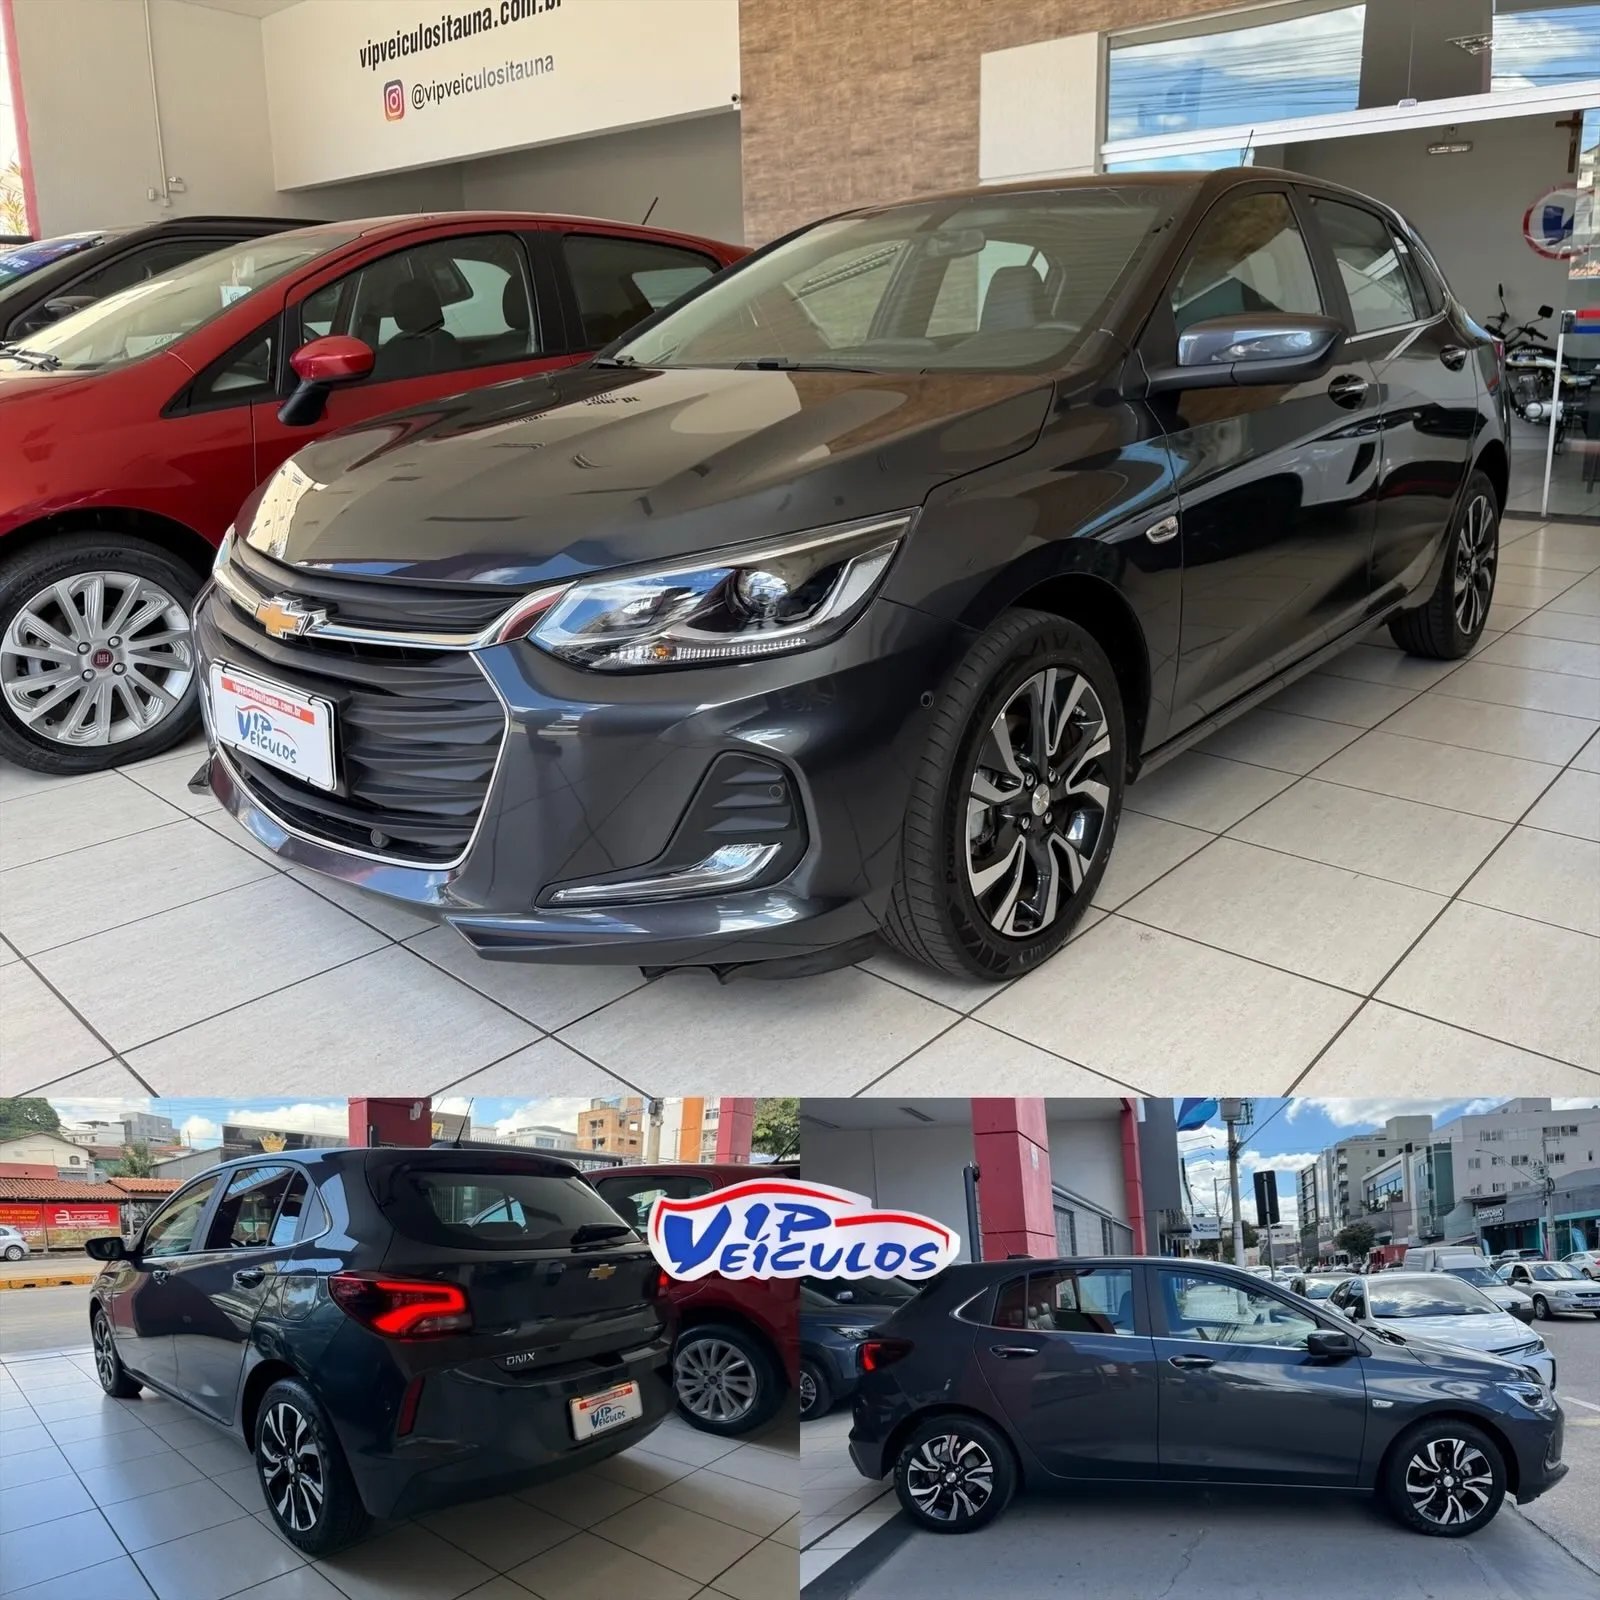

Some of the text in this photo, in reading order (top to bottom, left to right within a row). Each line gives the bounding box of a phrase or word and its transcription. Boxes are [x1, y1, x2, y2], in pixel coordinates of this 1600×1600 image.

[411, 54, 555, 110] @vipveiculositauna
[237, 710, 272, 741] VIP
[506, 1352, 535, 1366] ONIX
